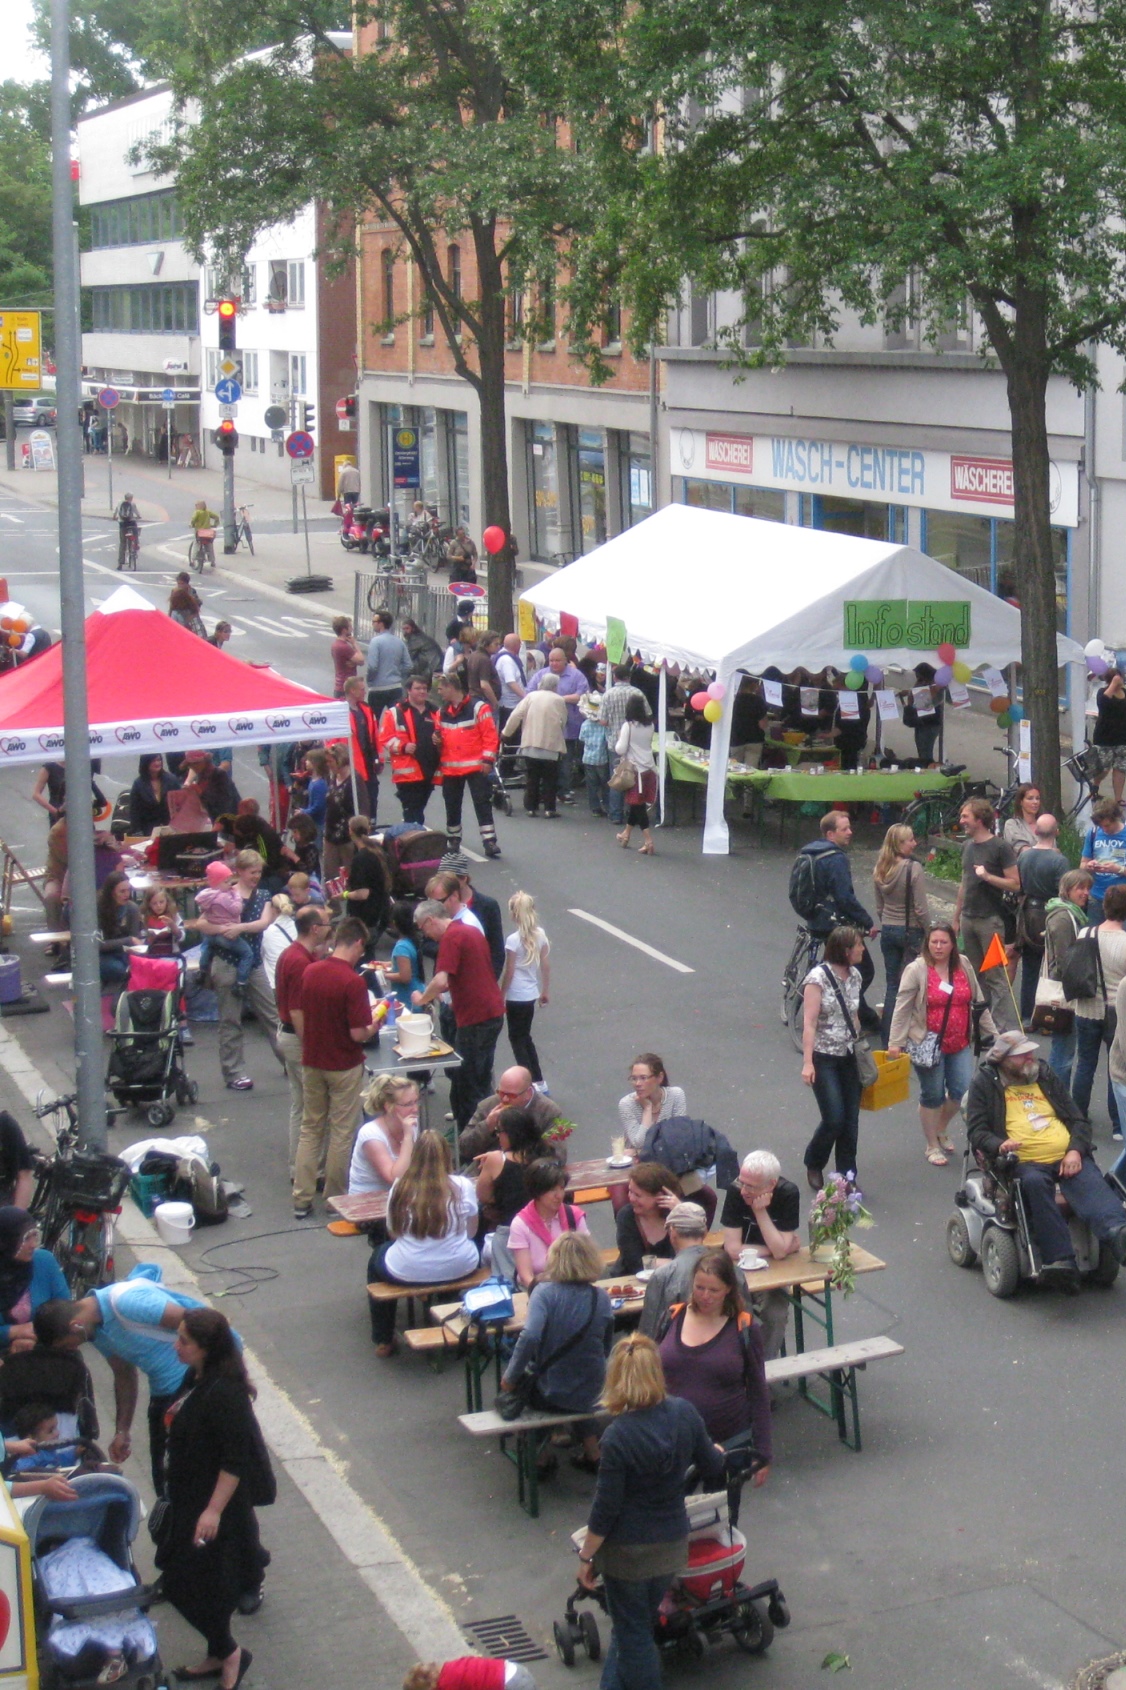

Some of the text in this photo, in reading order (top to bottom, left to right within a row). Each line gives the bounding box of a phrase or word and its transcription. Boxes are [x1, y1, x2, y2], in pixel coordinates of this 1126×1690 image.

[708, 440, 751, 466] WÄSCHEREI
[772, 437, 926, 496] WASCH-CENTER
[846, 604, 971, 647] Infostand
[272, 719, 291, 728] AWO
[309, 716, 327, 725] AWO
[198, 725, 216, 734] AWO
[235, 722, 254, 731] AWO
[122, 731, 141, 741] AWO
[160, 728, 179, 737] AWO
[46, 738, 65, 748] AWO
[89, 735, 103, 744] WO
[6, 742, 26, 751] AWO
[1094, 839, 1124, 848] ENJOY
